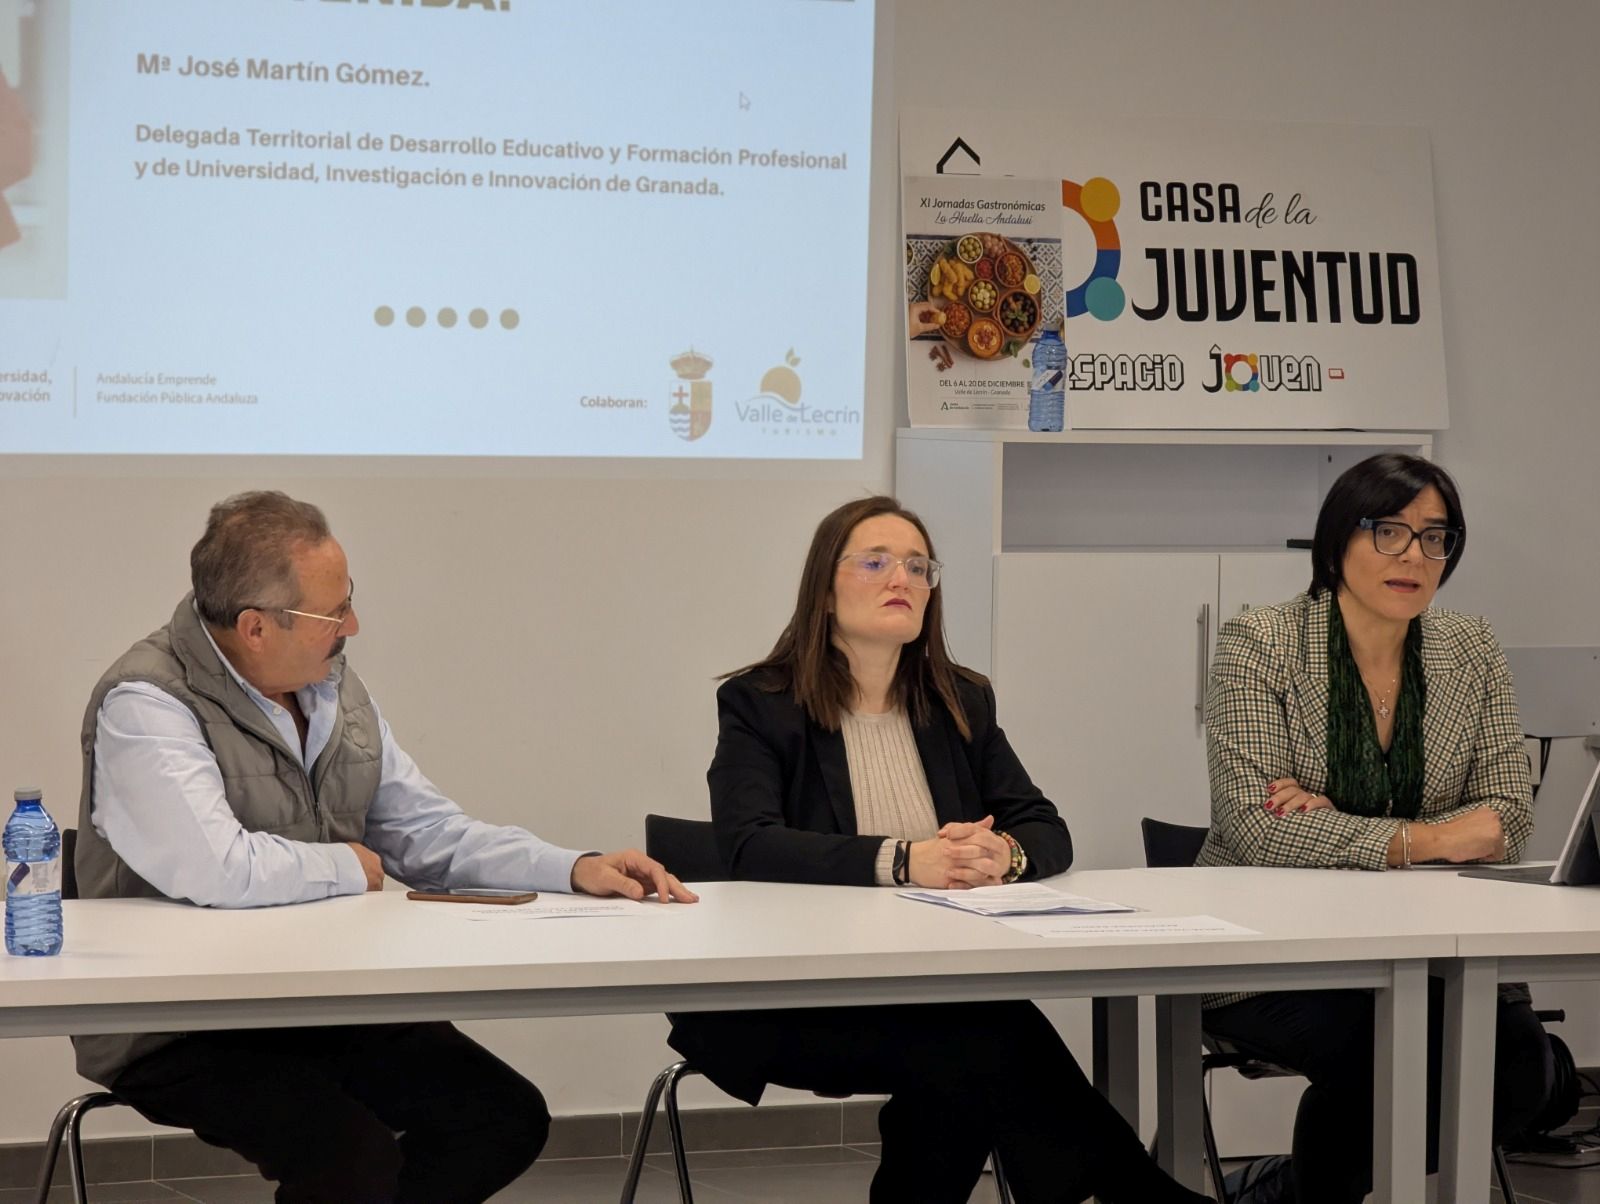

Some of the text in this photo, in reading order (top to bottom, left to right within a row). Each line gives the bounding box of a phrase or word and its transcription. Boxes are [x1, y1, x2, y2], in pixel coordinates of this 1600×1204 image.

[136, 53, 430, 87] Mª José Martín Gómez.
[135, 124, 848, 170] Delegada Territorial de Desarrollo Educativo y Formación Profesional
[135, 158, 725, 197] y de Universidad, Investigación e Innovación de Granada.
[920, 197, 1046, 212] XI Jornadas Gastronómicas
[1140, 181, 1318, 229] CASA de la
[934, 211, 946, 225] La
[949, 210, 984, 224] Huella
[1132, 248, 1420, 324] JUVENTUD
[97, 372, 217, 386] Andalucía Emprende
[940, 380, 1025, 388] DEL 6 AL 20 DE DICIEMBRE
[97, 390, 259, 405] Fundación Pública Andaluza
[580, 395, 648, 410] Colaboran:
[735, 399, 783, 424] Valle
